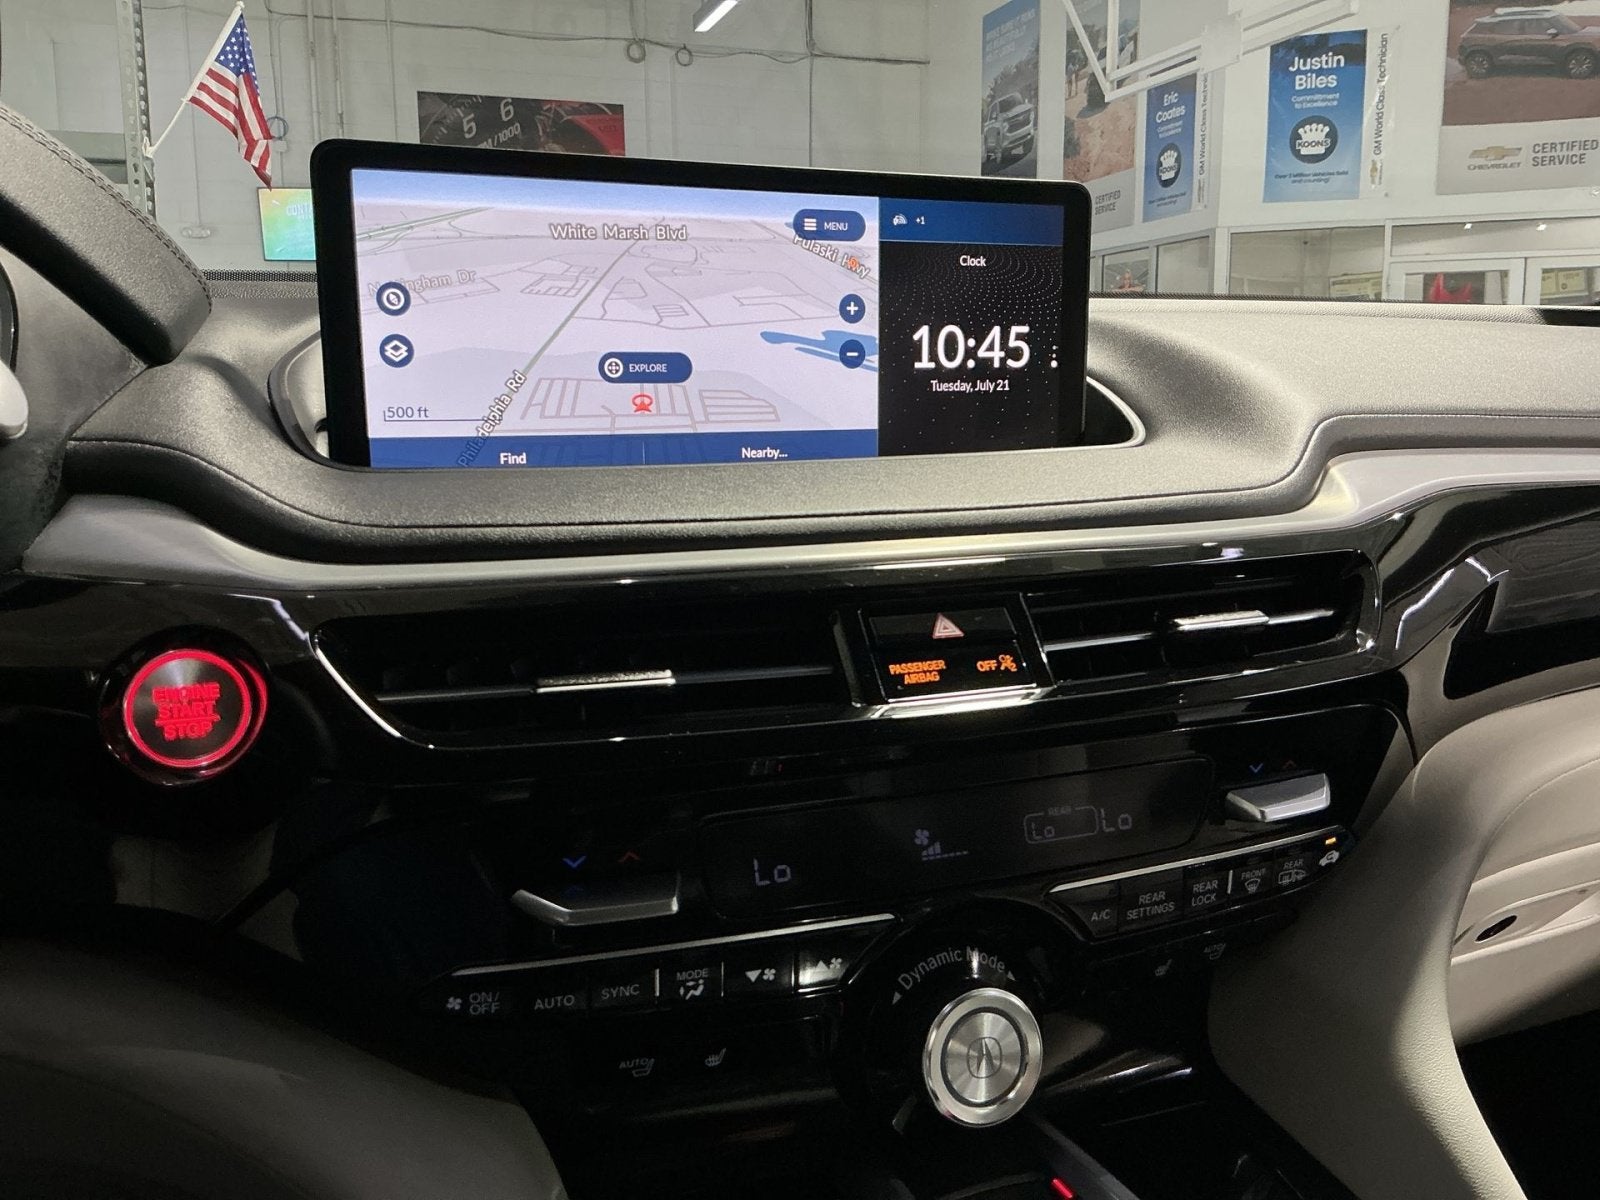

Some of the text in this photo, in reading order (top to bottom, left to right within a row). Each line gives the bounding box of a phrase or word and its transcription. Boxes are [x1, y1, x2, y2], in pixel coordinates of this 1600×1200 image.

[1288, 52, 1345, 73] Justin
[1377, 33, 1388, 84] Technician
[1295, 73, 1337, 90] Biles
[1163, 91, 1178, 107] Eric
[500, 98, 515, 122] 6
[1156, 105, 1185, 123] Coates
[462, 113, 477, 139] 5
[1374, 111, 1384, 139] World
[1297, 139, 1330, 148] KOONS
[1373, 140, 1382, 155] GM
[1532, 139, 1599, 154] CERTIFIED
[1467, 162, 1521, 171] CHEVROLET
[1532, 153, 1586, 167] SERVICE
[1095, 189, 1121, 205] CERTIFIED
[1095, 201, 1116, 215] SERVICE
[824, 221, 848, 232] MENU
[915, 216, 925, 225] +1
[549, 223, 689, 242] White Marsh Blvd
[959, 255, 987, 268] Clock
[456, 268, 477, 284] Dr
[912, 324, 1031, 369] 10:45
[629, 363, 668, 374] EXPLORE
[930, 379, 1010, 393] Tuesday, July 21
[387, 406, 429, 419] 500 ft
[457, 369, 527, 468] Philadelphia Rd
[500, 452, 527, 465] Find
[741, 446, 788, 460] Nearby...
[889, 660, 946, 675] PASSENGER
[976, 660, 998, 672] OFF
[904, 672, 940, 685] AIRBAG
[152, 682, 221, 703] ENGINE
[158, 701, 216, 719] START
[164, 720, 213, 741] STOP
[1100, 808, 1133, 832] Lo
[1283, 858, 1304, 869] REAR
[754, 857, 792, 886] Lo
[1241, 867, 1267, 880] FRONT
[1193, 880, 1219, 894] REAR
[1138, 890, 1166, 906] REAR
[1191, 894, 1217, 907] LOCK
[1091, 908, 1110, 921] A/C
[1126, 902, 1175, 921] SETTINGS
[676, 968, 709, 980] MODE
[898, 945, 1006, 990] Dynamic Mode
[469, 992, 500, 1003] ON/
[601, 984, 641, 999] SYNC
[469, 1002, 501, 1016] OFF
[534, 995, 575, 1010] AUTO
